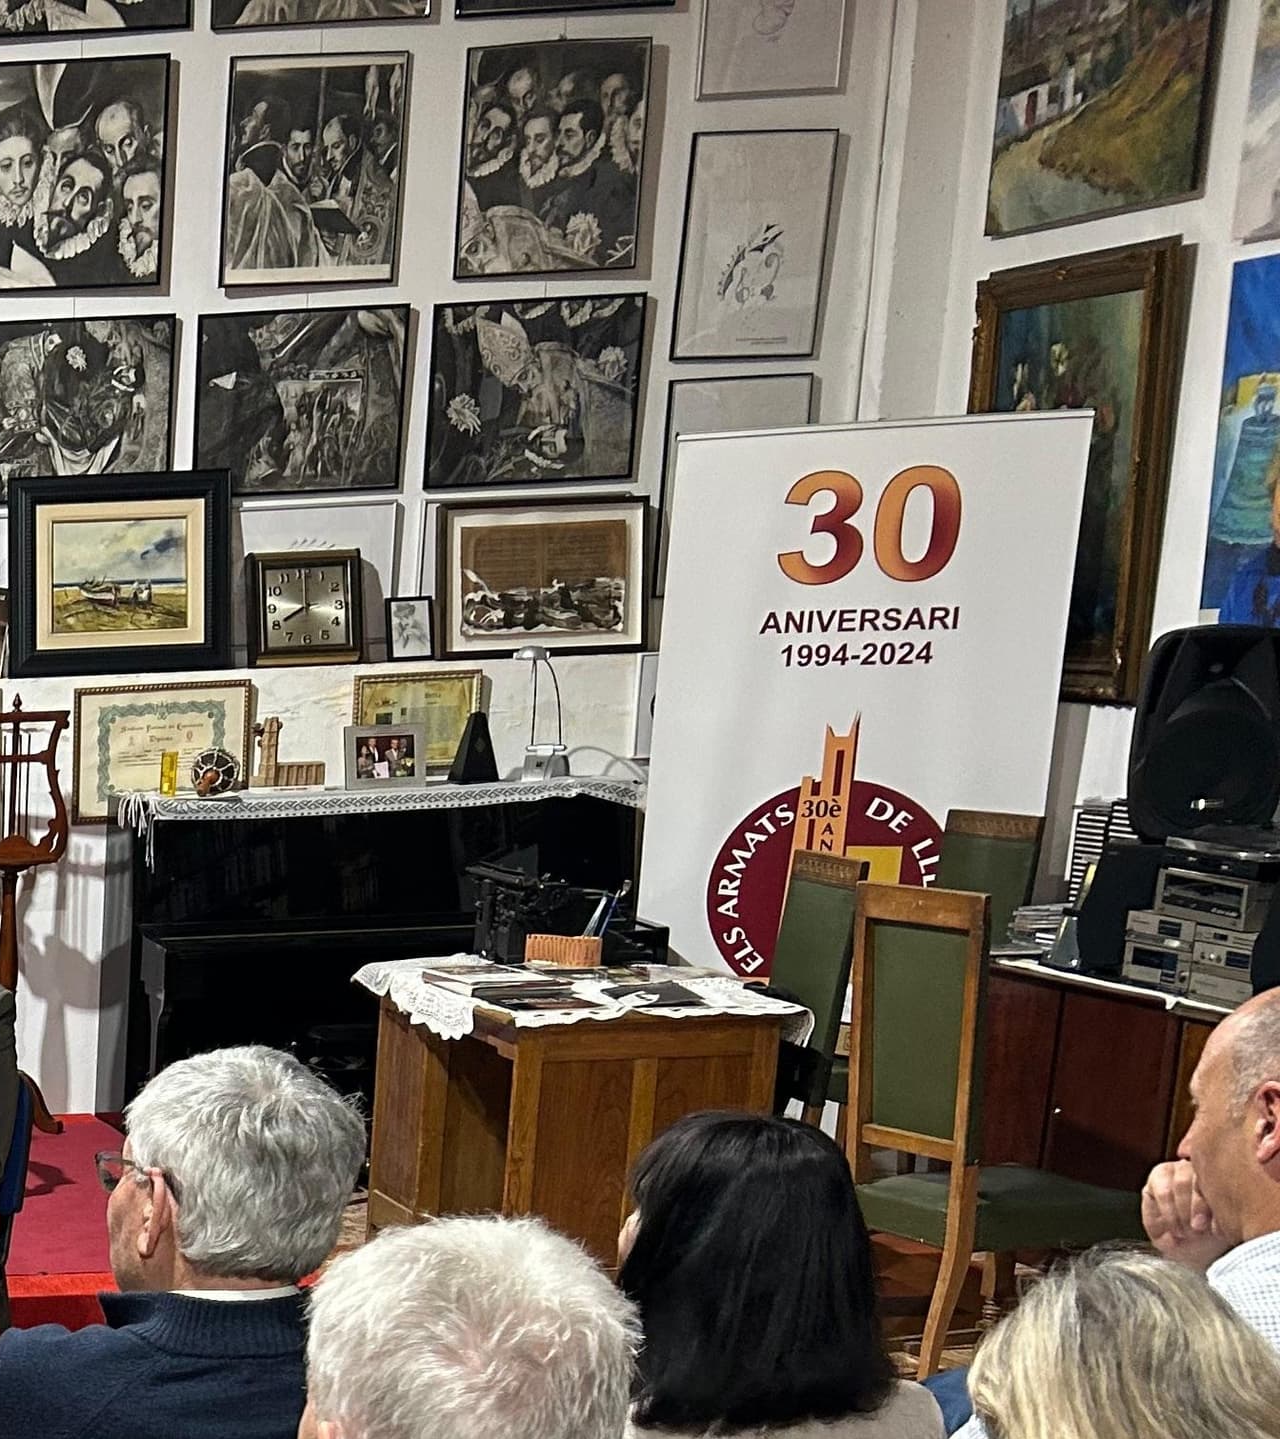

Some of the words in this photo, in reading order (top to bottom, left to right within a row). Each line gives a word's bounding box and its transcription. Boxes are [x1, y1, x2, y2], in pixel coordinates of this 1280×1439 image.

[777, 464, 962, 586] 30
[268, 586, 281, 597] 10
[331, 582, 340, 592] 2
[268, 604, 277, 614] 9
[334, 600, 343, 610] 3
[272, 620, 281, 630] 8
[331, 616, 341, 626] 4
[759, 606, 960, 634] ANIVERSARI
[285, 632, 293, 642] 7
[303, 634, 312, 645] 6
[321, 630, 330, 640] 5
[780, 641, 933, 668] 1994-2024
[801, 798, 841, 819] 30è
[864, 797, 915, 834] DE
[717, 803, 796, 918] ARMATS
[723, 926, 765, 973] ELS
